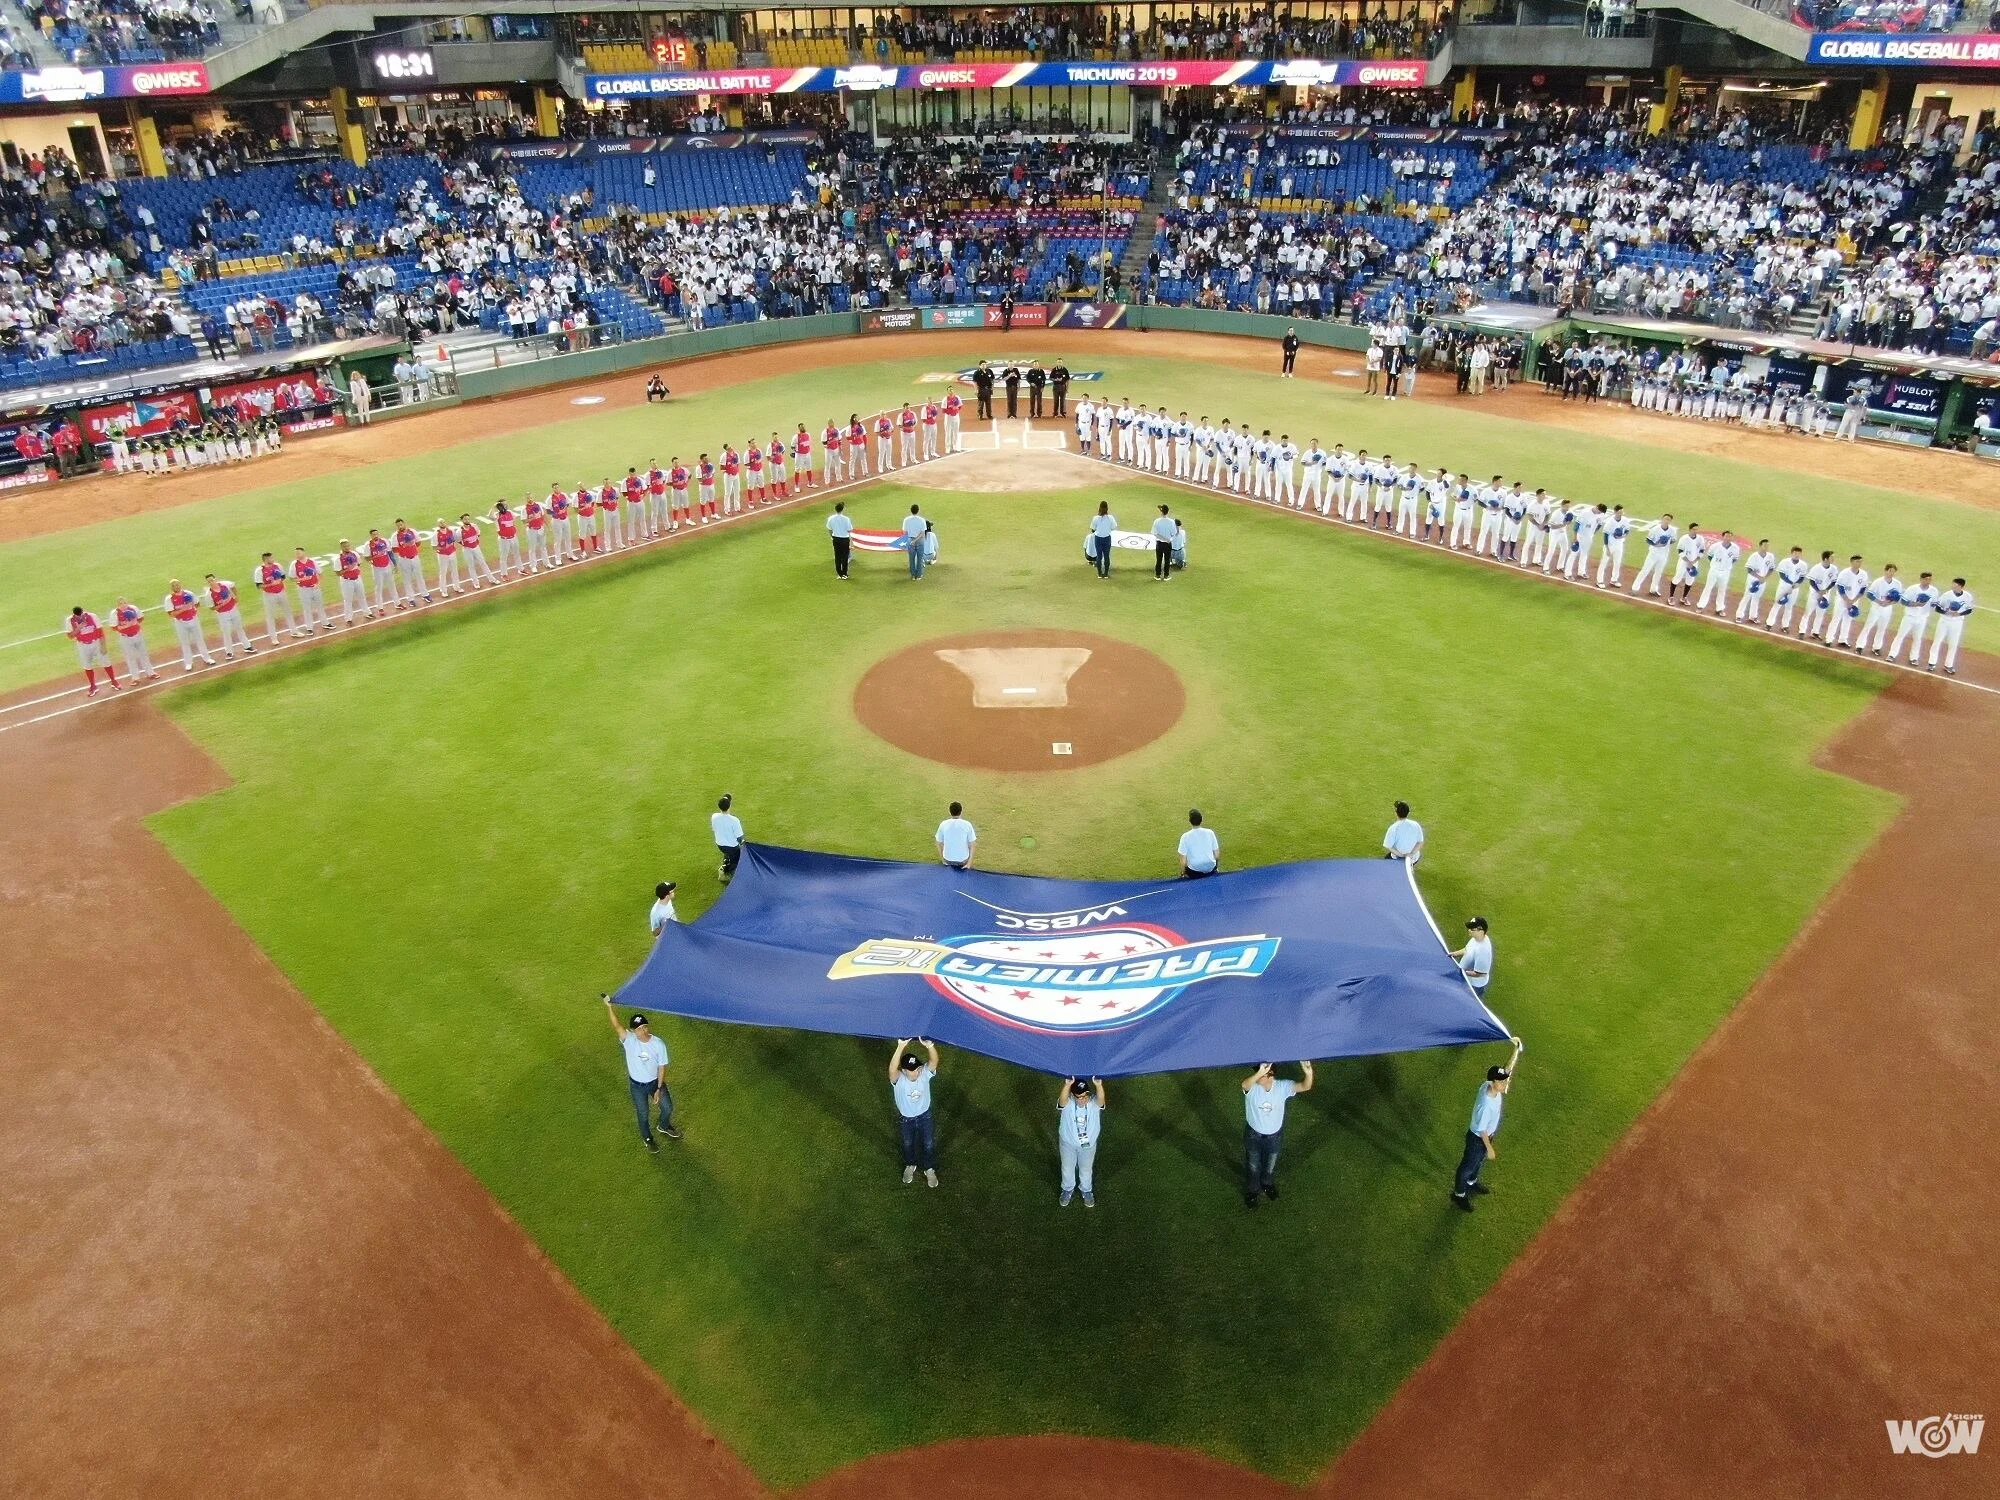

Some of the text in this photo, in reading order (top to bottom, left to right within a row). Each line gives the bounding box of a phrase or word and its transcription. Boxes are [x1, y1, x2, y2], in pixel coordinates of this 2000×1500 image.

[656, 43, 686, 62] 2:15
[1820, 41, 2000, 61] GLOBAL BASEBALL BA
[132, 71, 201, 93] @WBSC
[920, 70, 975, 86] @WBSC
[1067, 68, 1177, 80] TAICHUNG 2019
[1359, 67, 1419, 83] @WBSC
[596, 75, 771, 94] GLOBAL BASEBALL BATTLE
[880, 313, 916, 322] MITSUBISHI
[885, 320, 911, 328] MOTORS
[1894, 384, 1935, 397] HUBLOT
[1906, 402, 1930, 412] SSK
[994, 905, 1127, 932] WBSC
[852, 944, 1259, 986] PREMIER 12
